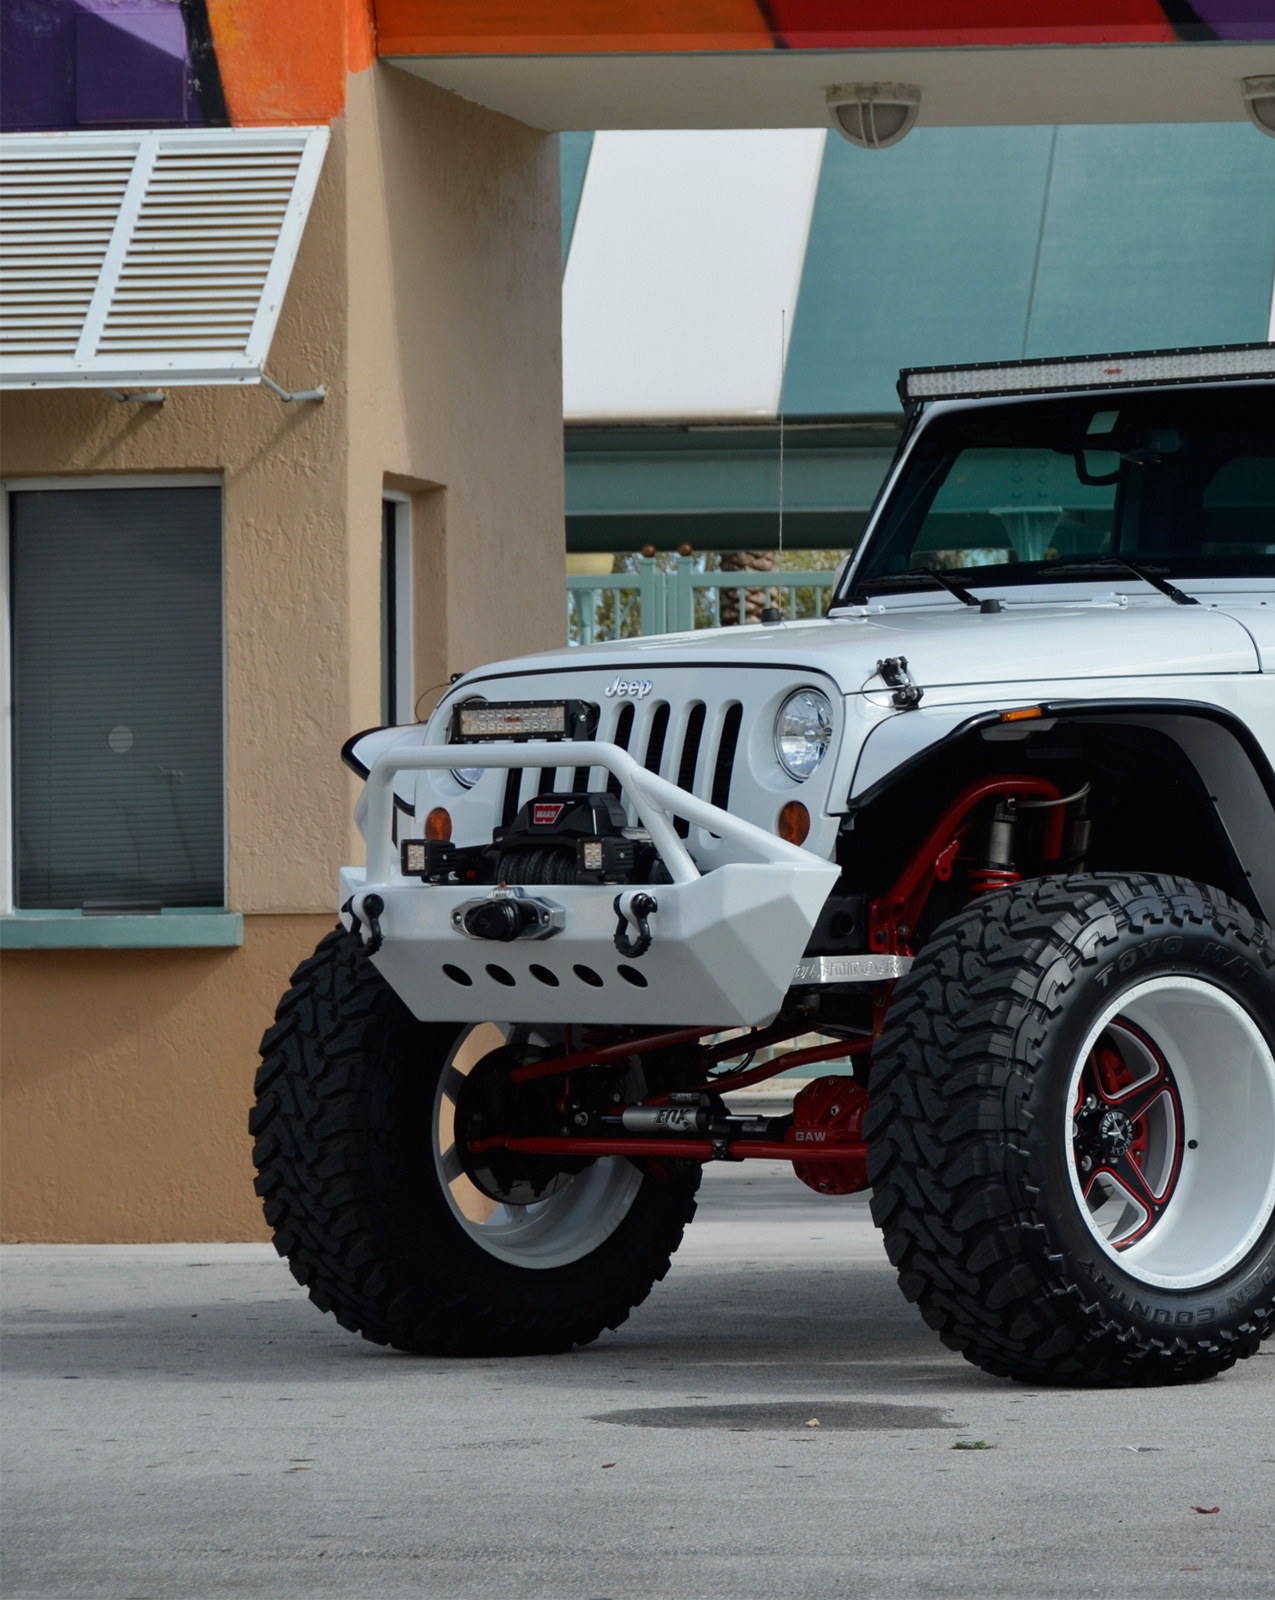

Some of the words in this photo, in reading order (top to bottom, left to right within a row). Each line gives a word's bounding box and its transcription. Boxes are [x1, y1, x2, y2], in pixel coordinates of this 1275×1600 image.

[604, 676, 653, 701] Jeep
[1094, 935, 1184, 988] TOYO
[655, 1107, 695, 1131] FOX
[795, 1131, 827, 1142] GAW
[1077, 1258, 1216, 1328] COUNTRY
